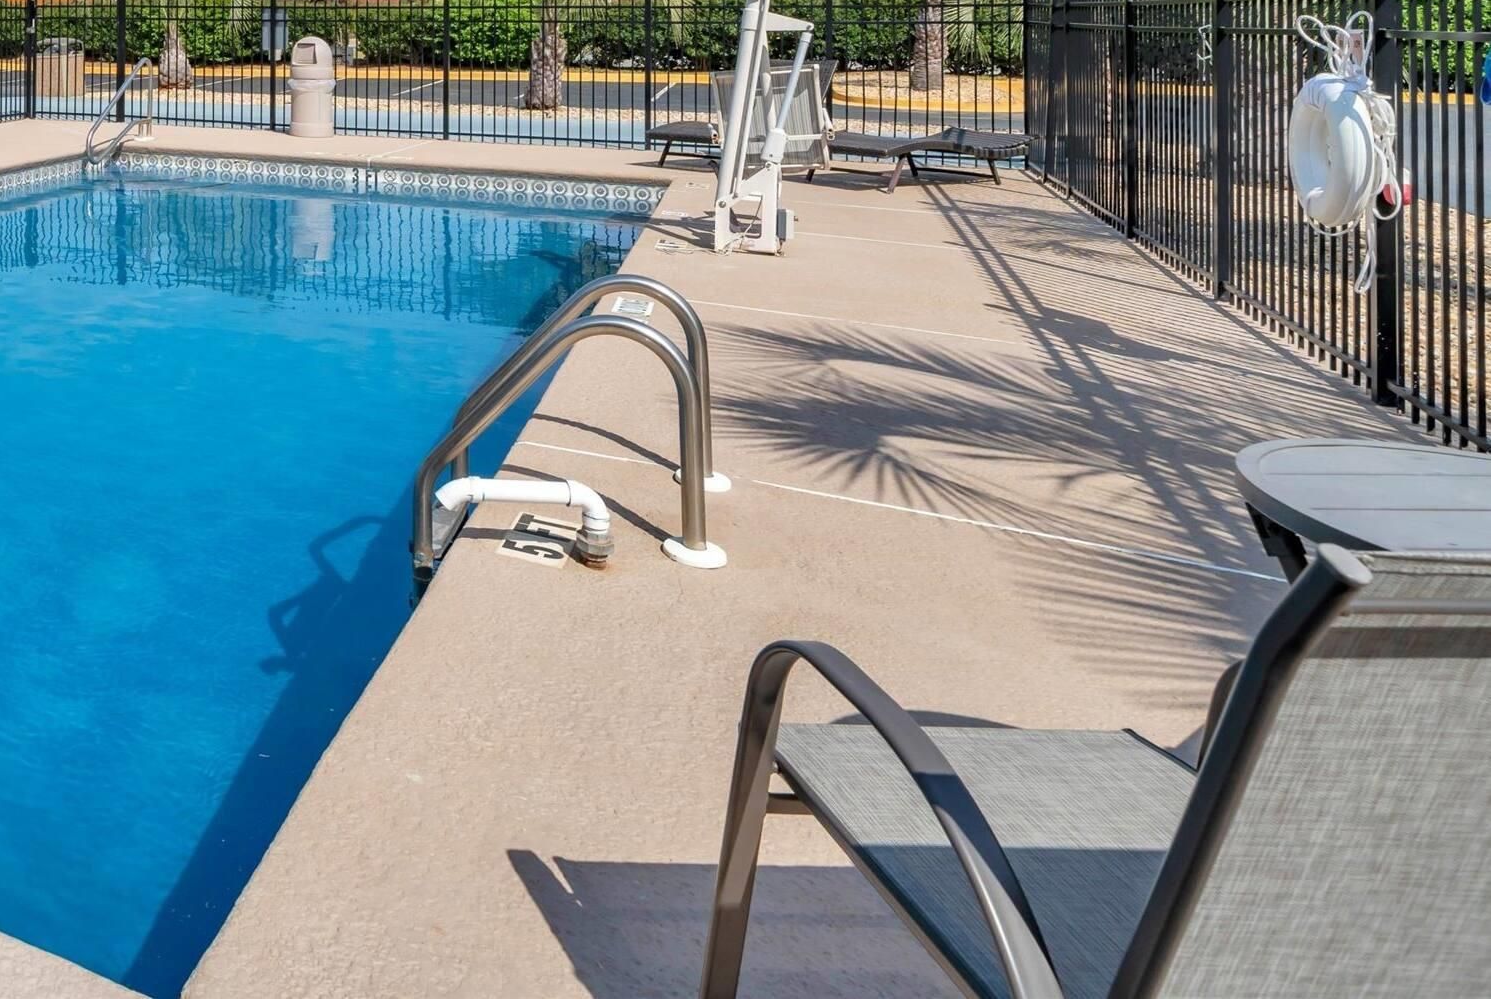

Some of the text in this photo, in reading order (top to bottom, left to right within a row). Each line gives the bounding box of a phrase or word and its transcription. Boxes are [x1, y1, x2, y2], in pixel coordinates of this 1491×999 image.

[352, 167, 379, 184] 3 FT
[501, 513, 577, 560] 5 FT
